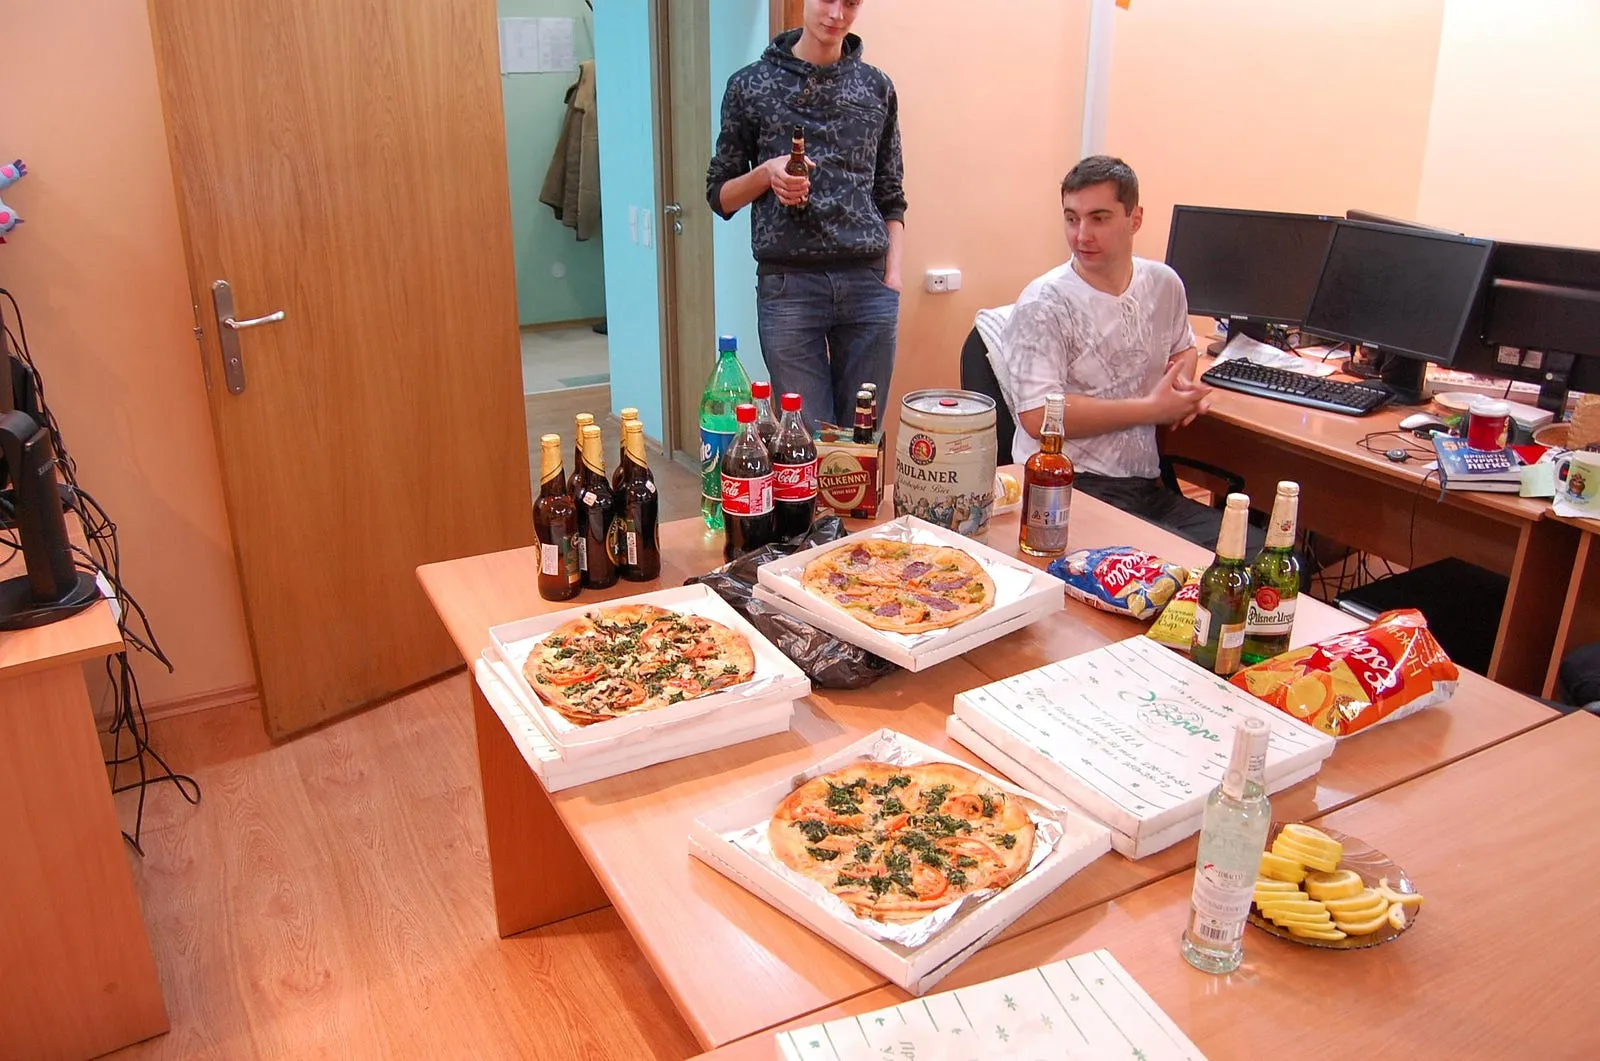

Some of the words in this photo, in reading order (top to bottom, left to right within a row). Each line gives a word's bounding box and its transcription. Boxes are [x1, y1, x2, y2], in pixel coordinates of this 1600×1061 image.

[896, 458, 958, 484] PAULANER
[1468, 462, 1511, 470] ЛЕГКО
[819, 473, 867, 488] KILKENNY
[1248, 606, 1277, 626] Pilsner
